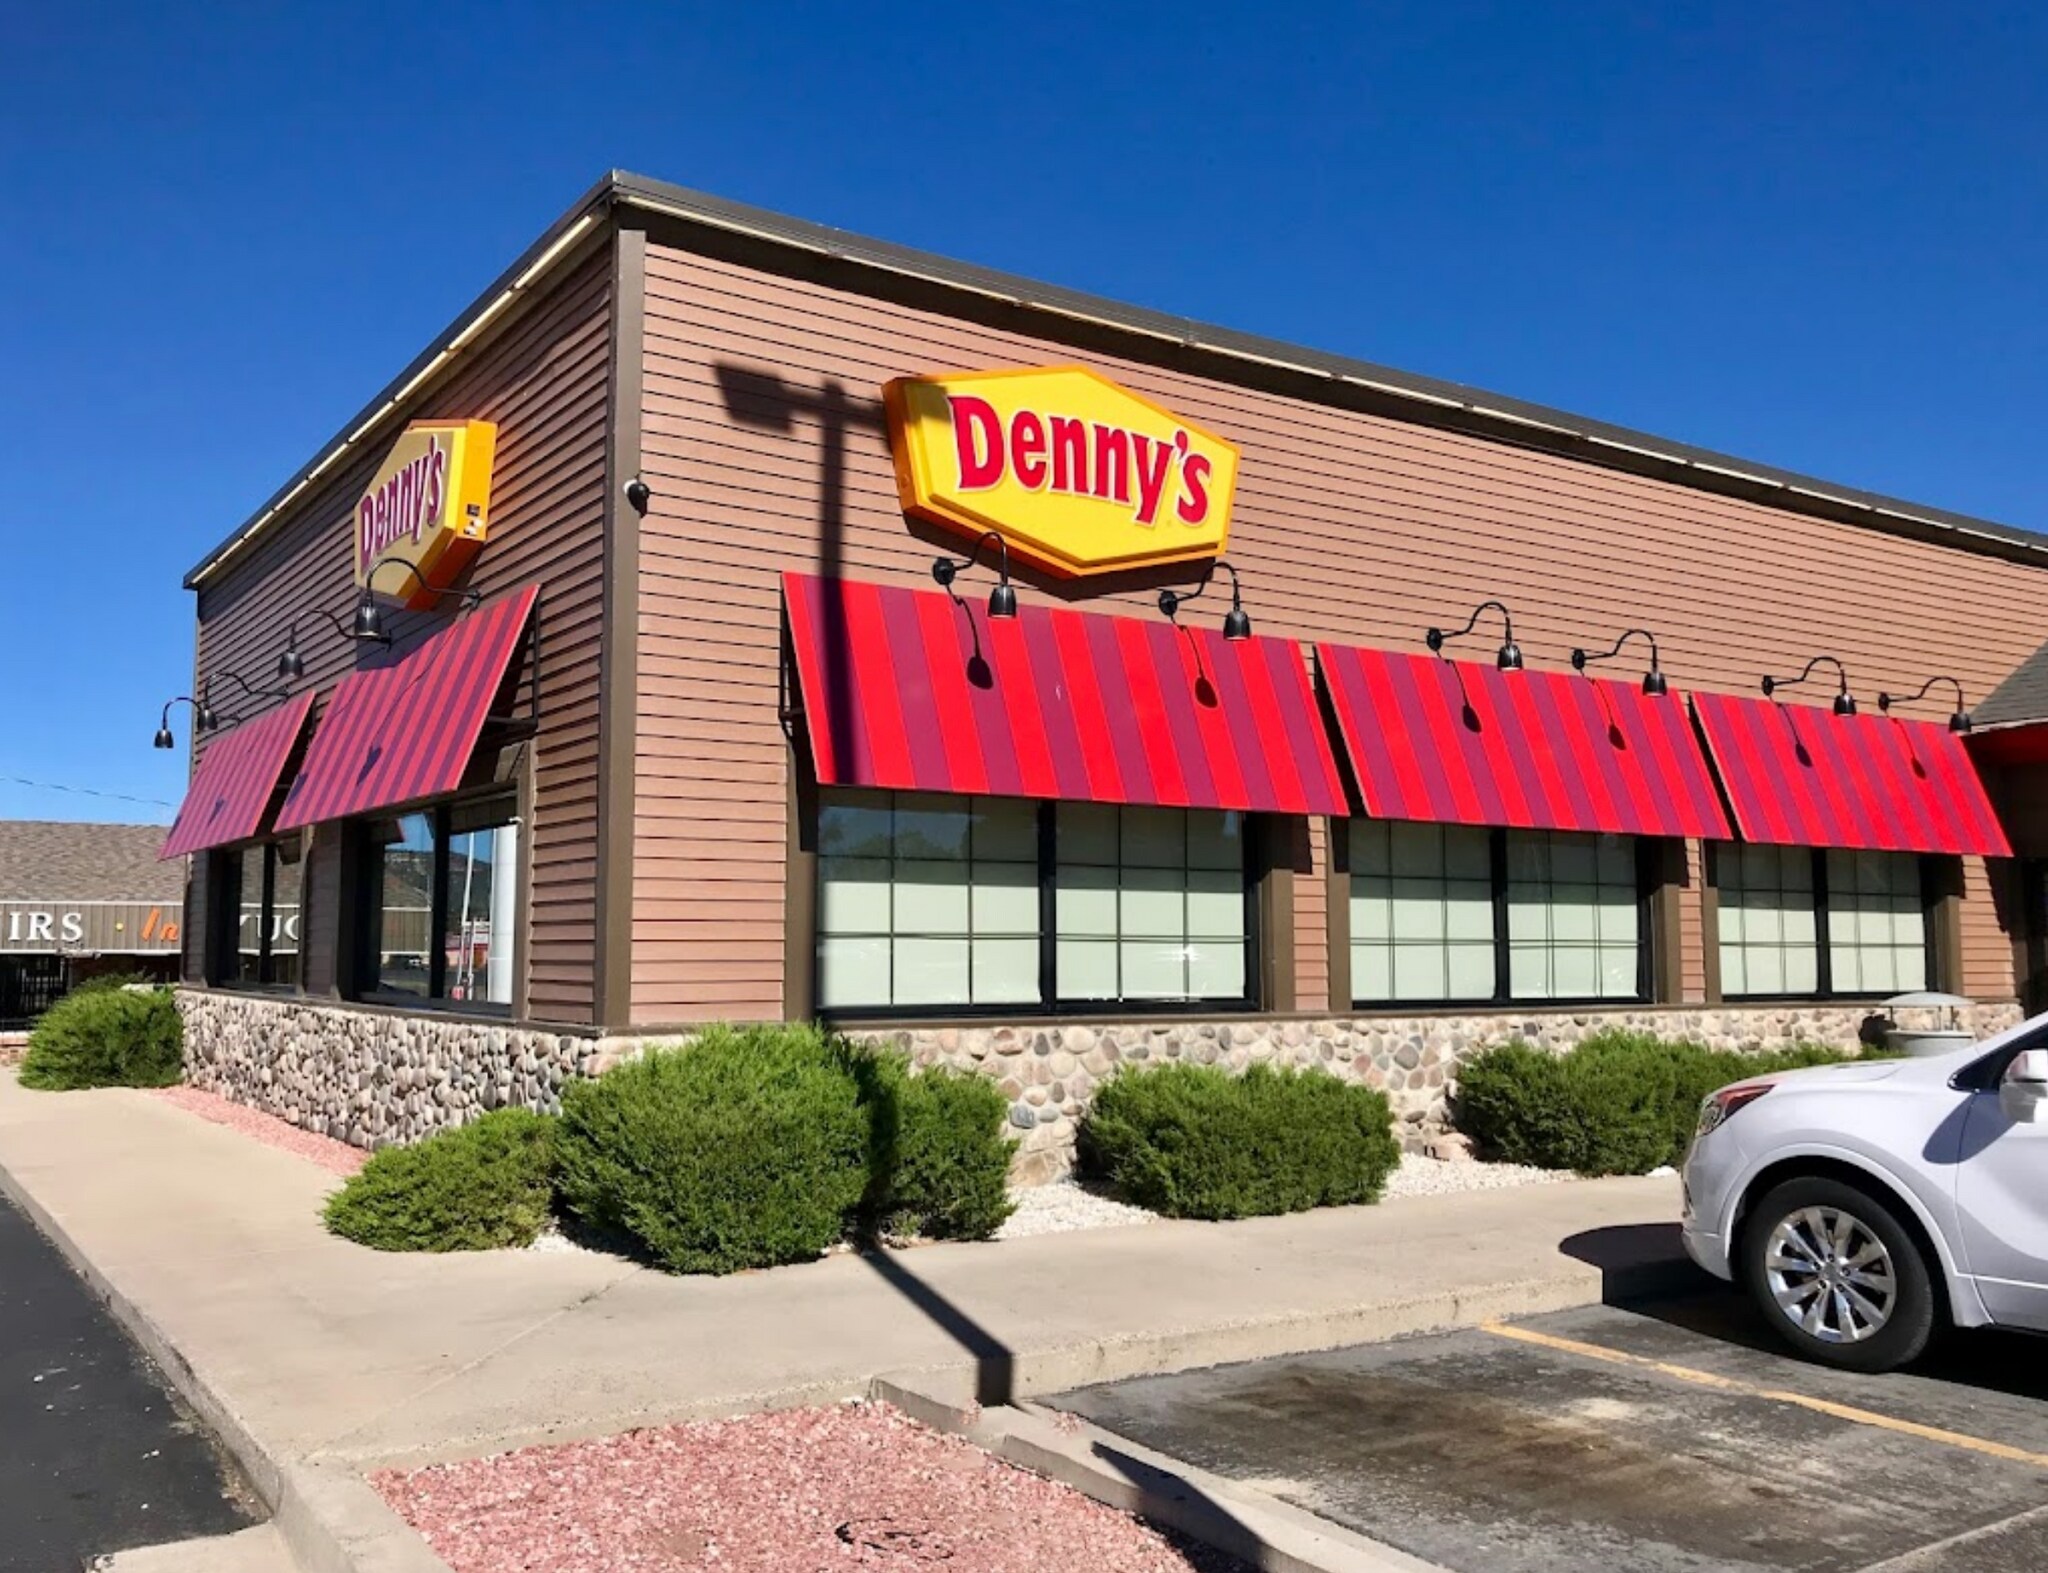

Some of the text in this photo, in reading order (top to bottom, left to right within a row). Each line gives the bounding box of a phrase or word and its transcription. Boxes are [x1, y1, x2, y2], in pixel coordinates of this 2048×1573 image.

[360, 433, 446, 578] Denny's
[947, 395, 1212, 525] Denny's
[0, 911, 83, 942] IRS
